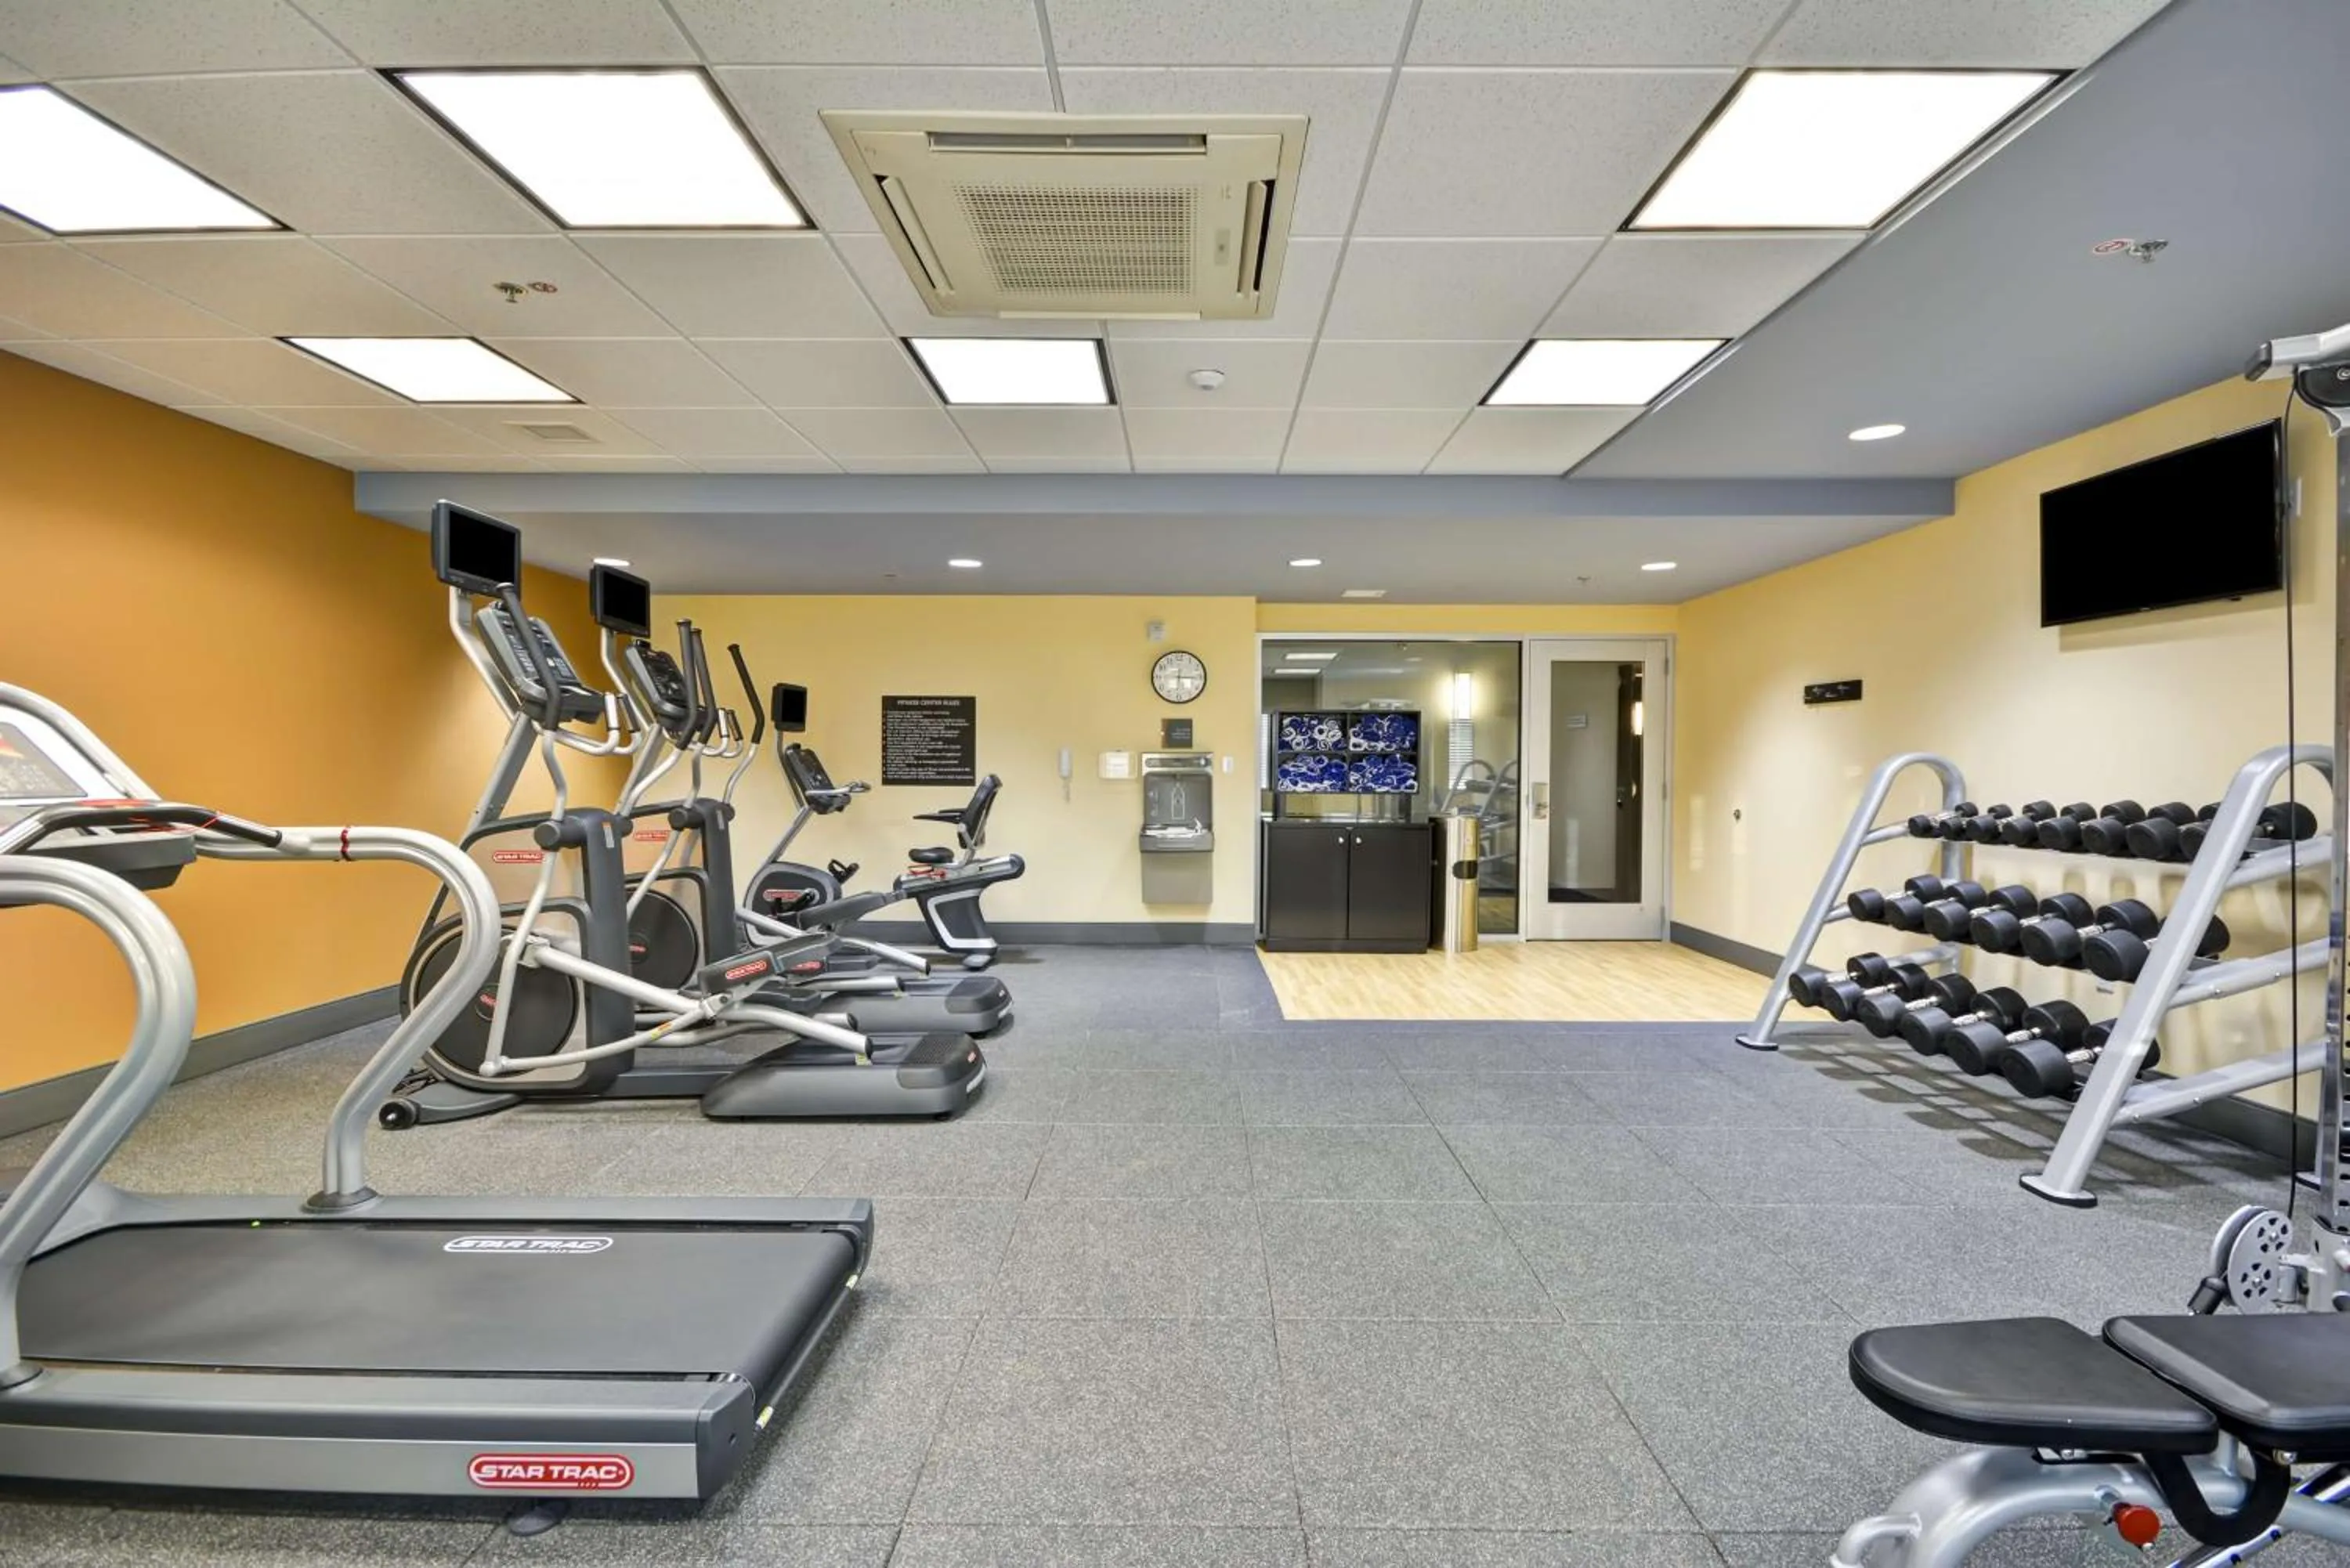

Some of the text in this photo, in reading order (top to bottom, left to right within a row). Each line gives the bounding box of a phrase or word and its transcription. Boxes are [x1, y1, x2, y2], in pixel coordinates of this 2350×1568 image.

[454, 1240, 598, 1249] STAR TRAC
[476, 1465, 618, 1479] STAR TRAC
